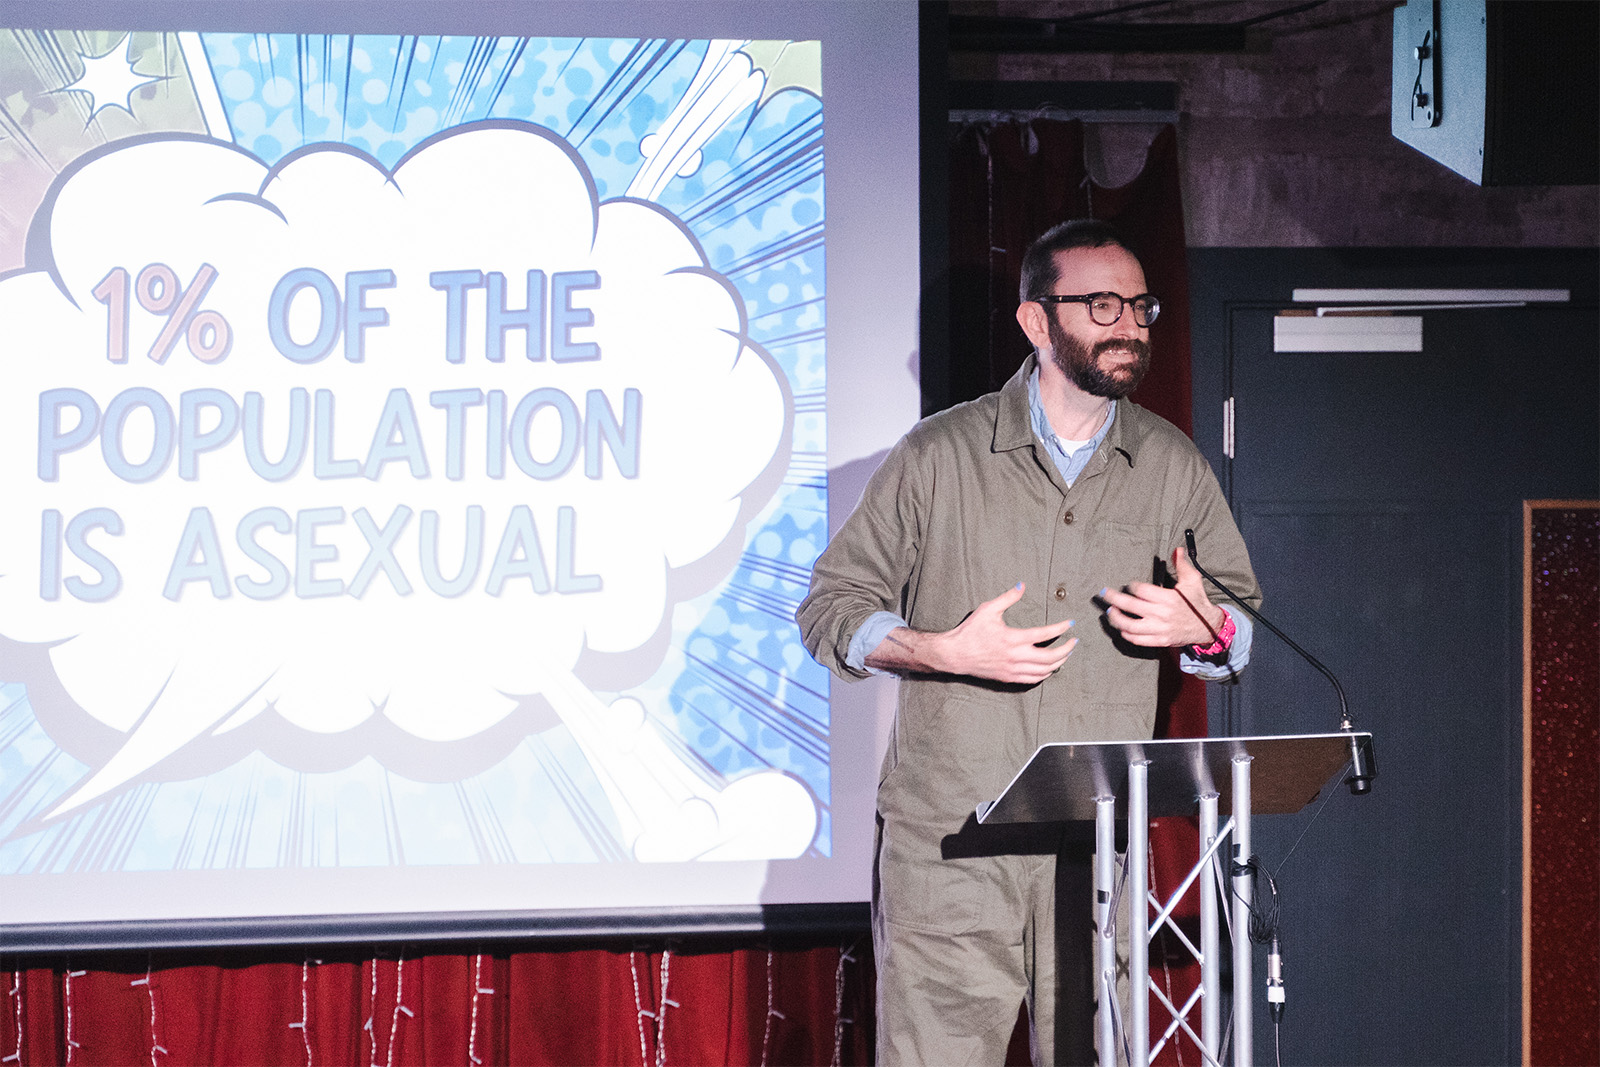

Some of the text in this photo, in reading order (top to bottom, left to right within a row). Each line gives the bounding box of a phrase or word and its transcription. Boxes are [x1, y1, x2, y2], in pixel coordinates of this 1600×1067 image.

[91, 262, 601, 365] 1% OF THE
[37, 387, 641, 483] POPULATION
[39, 504, 603, 602] IS ASEXUAL
